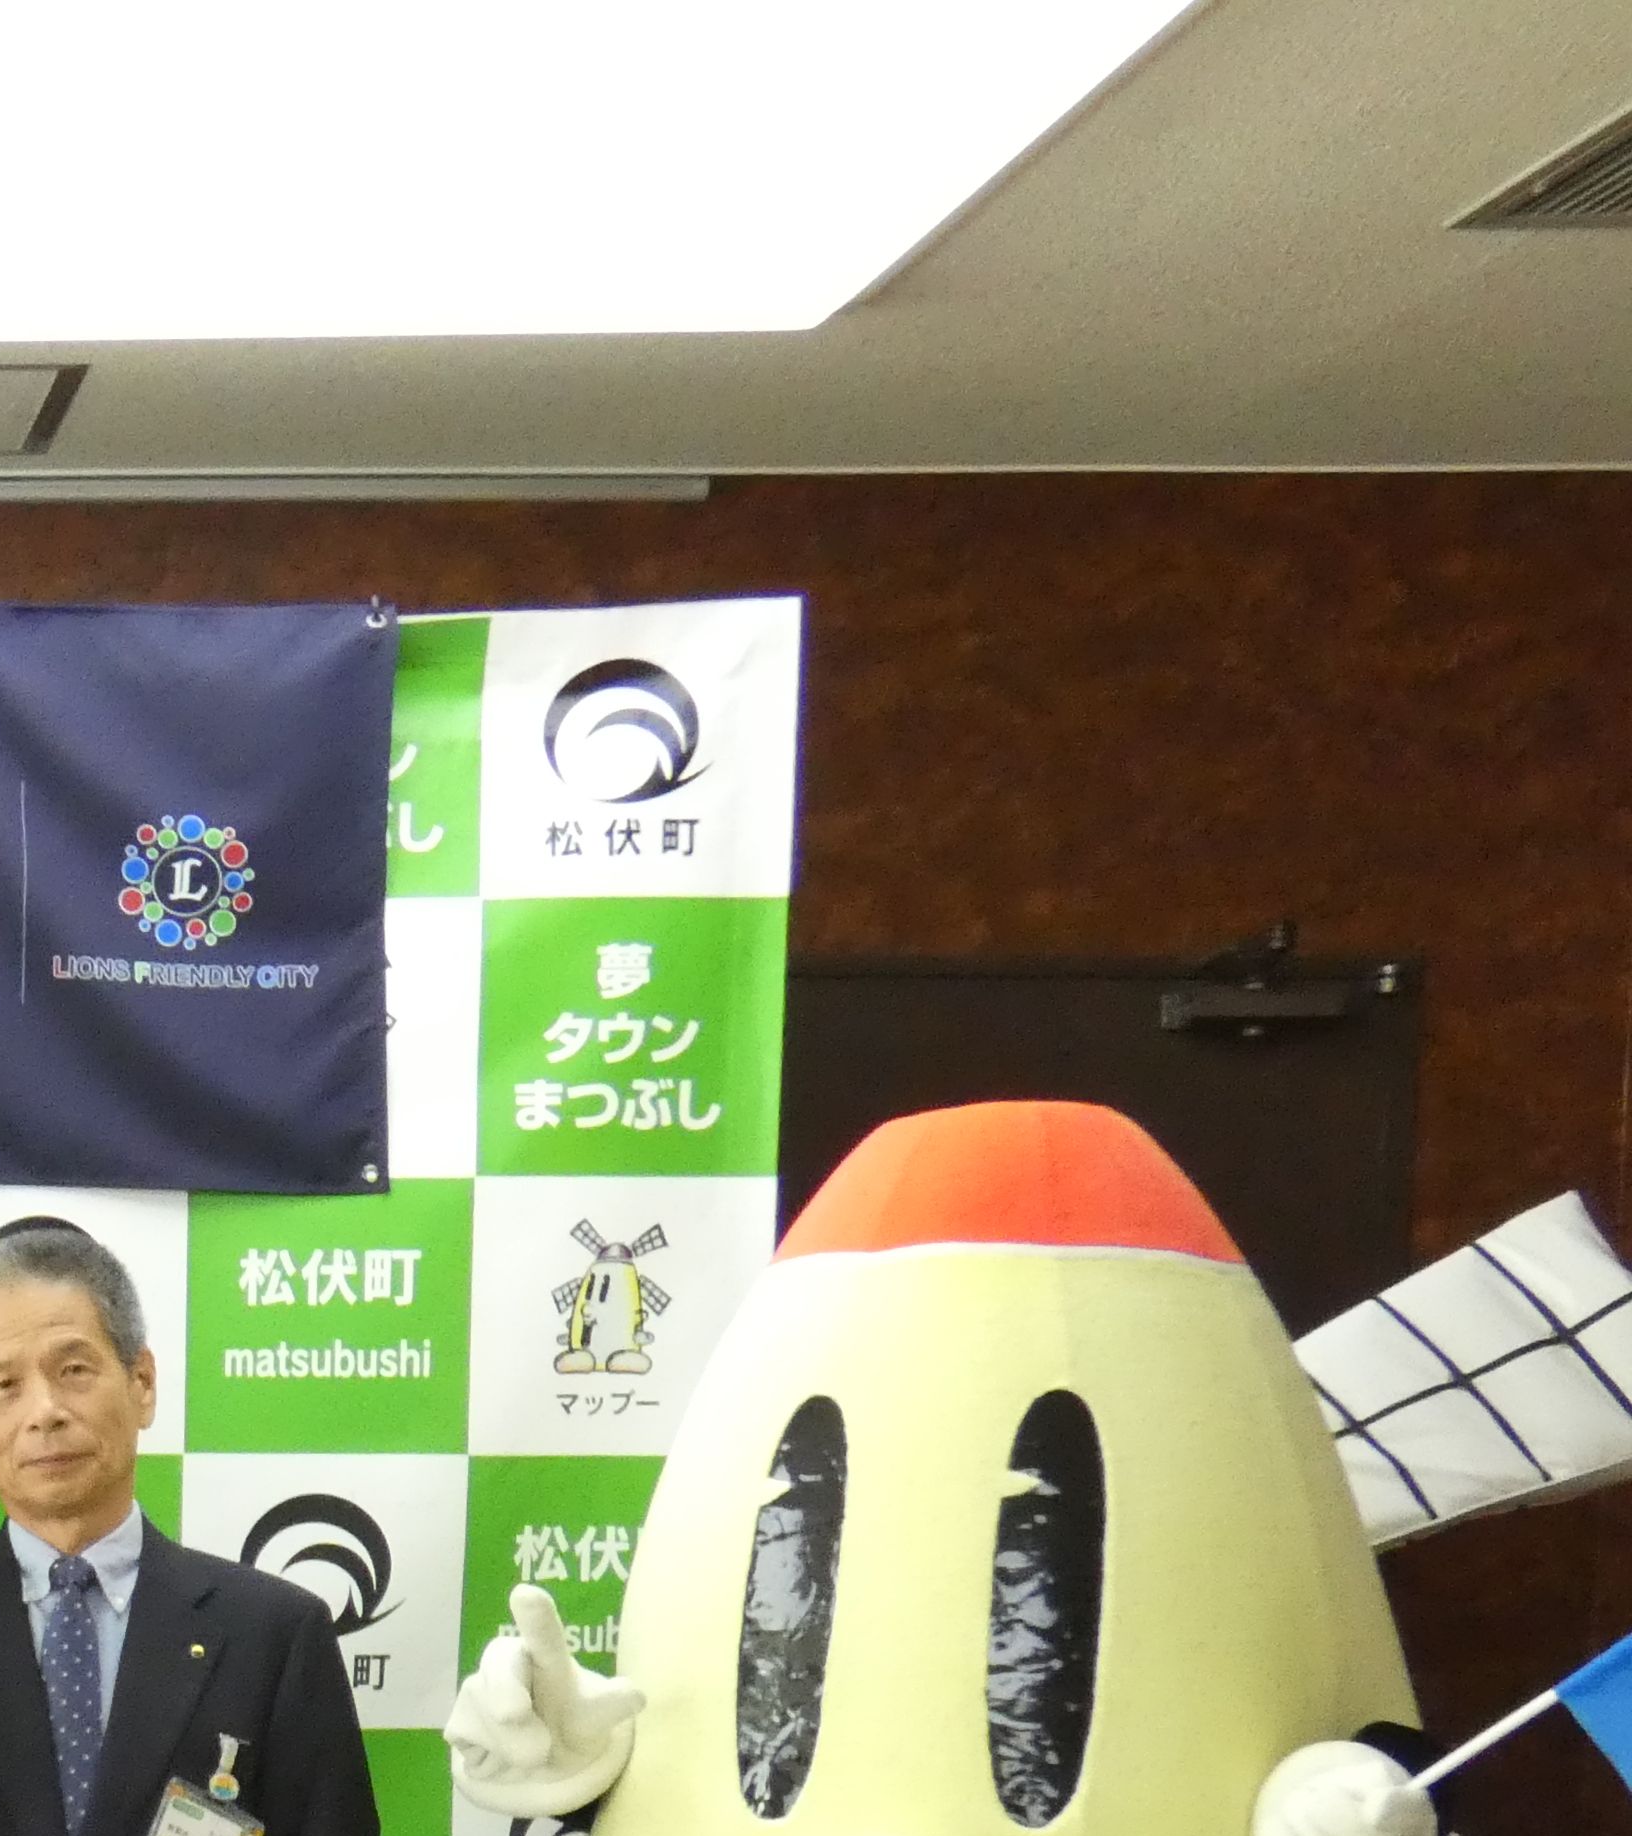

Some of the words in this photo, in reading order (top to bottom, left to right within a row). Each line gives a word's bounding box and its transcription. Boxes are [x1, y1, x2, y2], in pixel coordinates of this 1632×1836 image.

[544, 819, 701, 857] 松伏町
[168, 857, 209, 902] L
[52, 954, 131, 983] LIONS
[134, 960, 254, 988] FRIENDLY
[256, 964, 320, 989] CITY
[595, 944, 653, 998] 夢
[541, 1014, 698, 1064] タウン
[513, 1077, 721, 1131] まつぶし
[238, 1248, 421, 1307] 松伏町
[223, 1339, 432, 1379] matsubushi
[514, 1524, 643, 1582] 松伏
